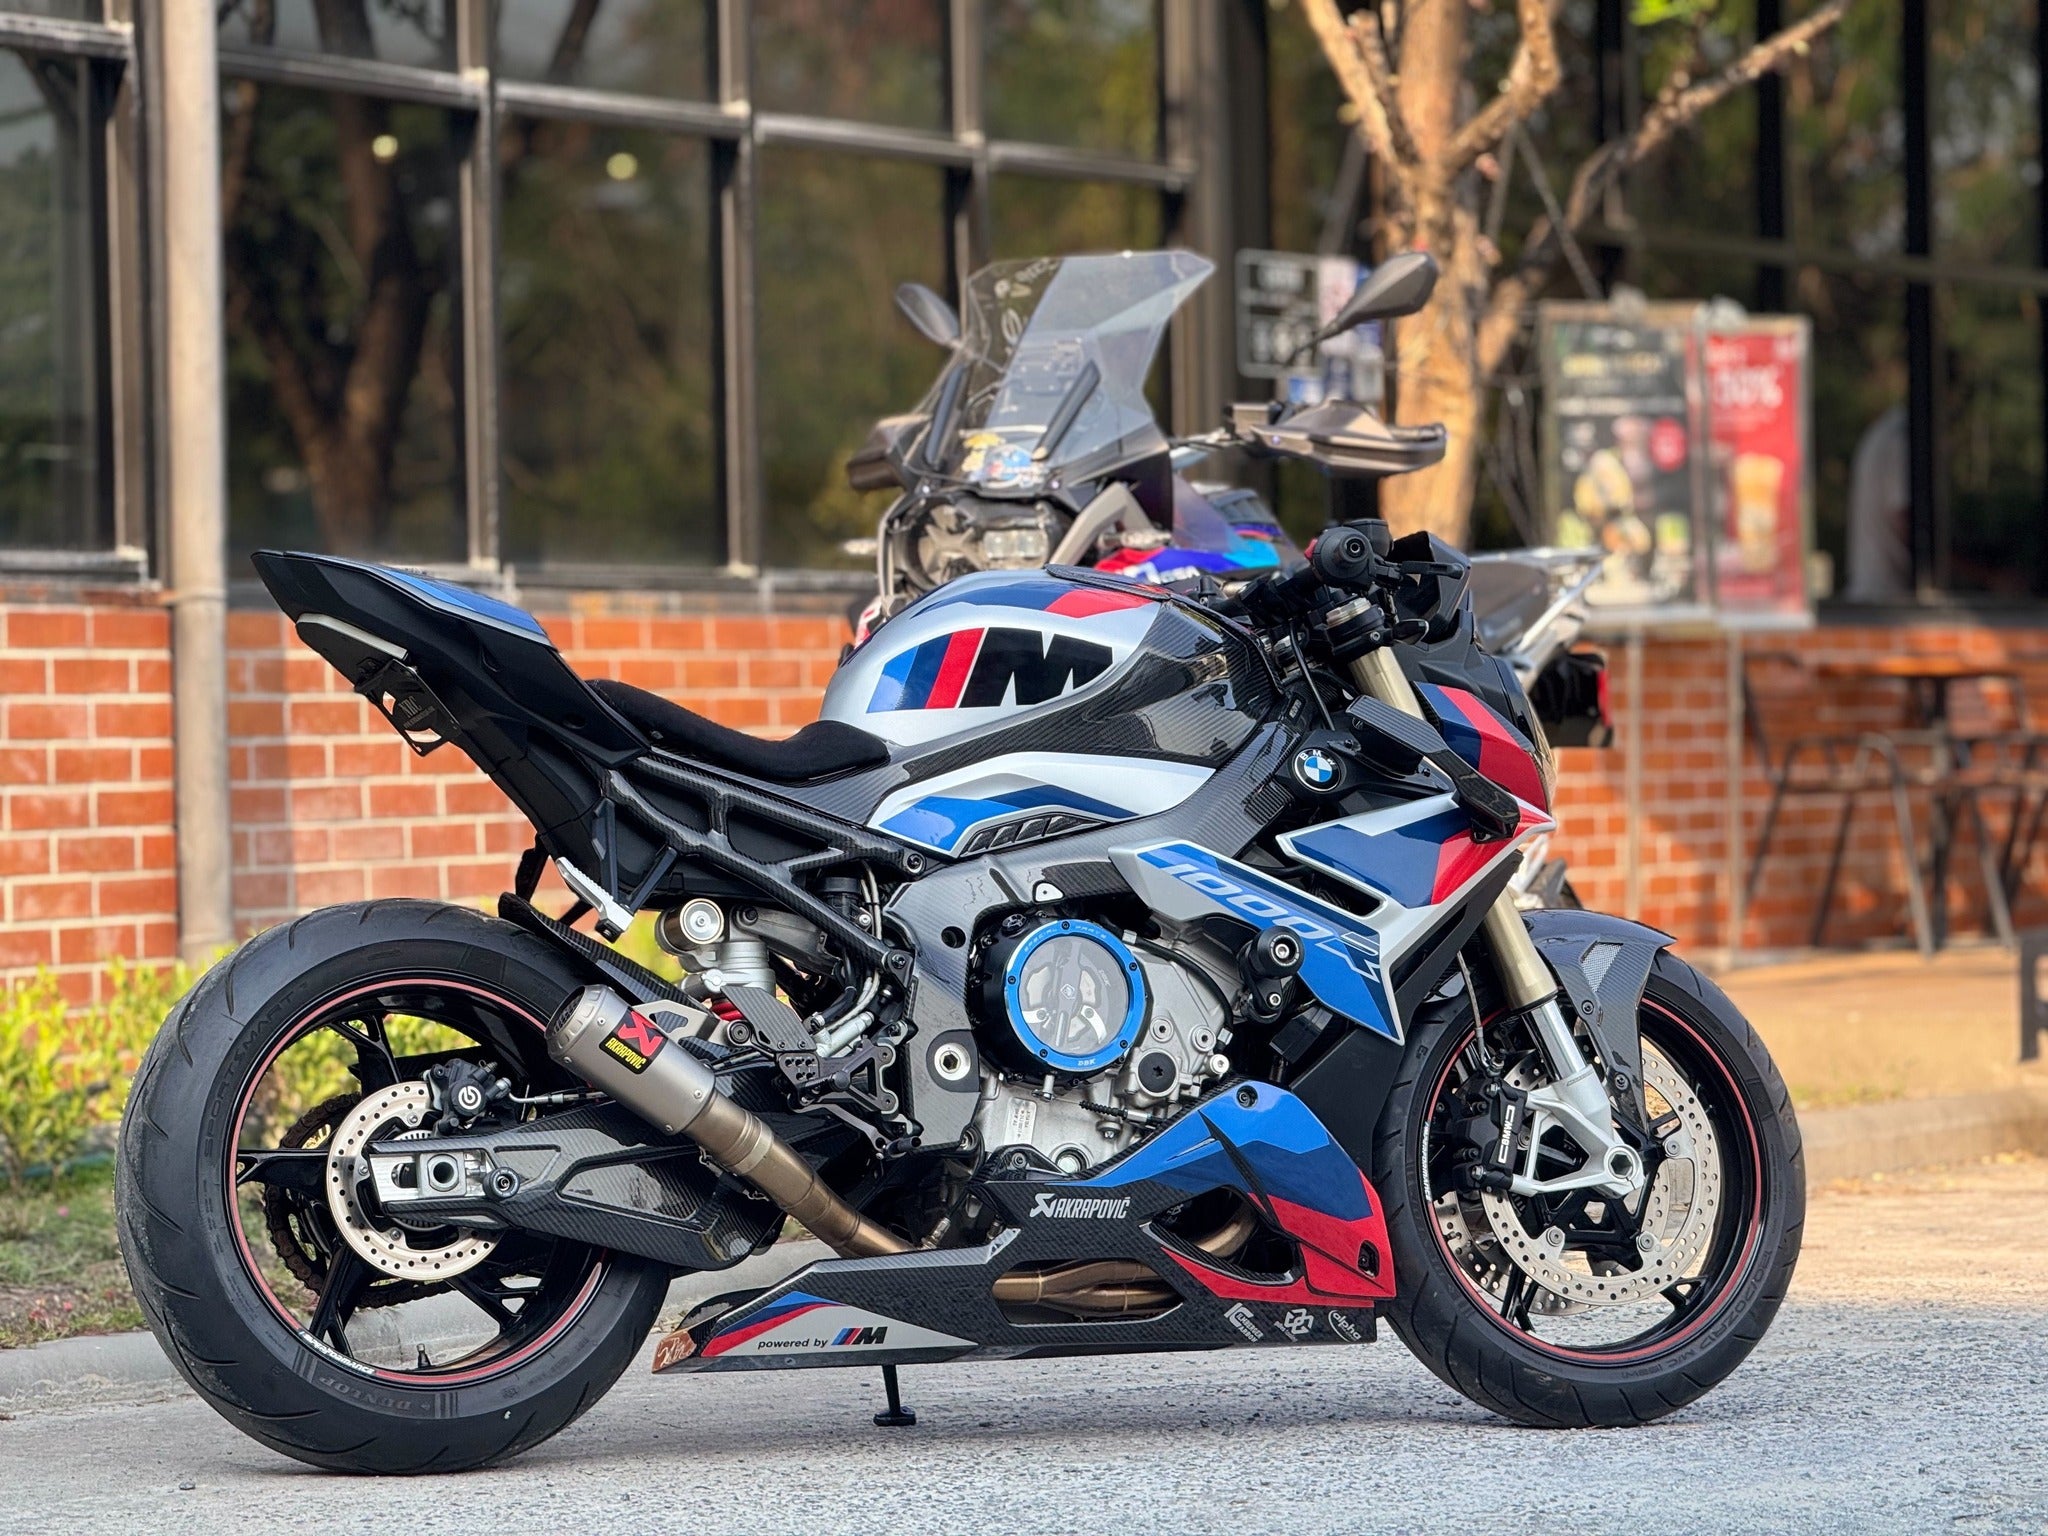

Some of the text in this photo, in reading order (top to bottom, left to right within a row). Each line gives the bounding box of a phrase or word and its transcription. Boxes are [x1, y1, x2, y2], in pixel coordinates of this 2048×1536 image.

[958, 626, 1114, 709] M
[1502, 1120, 1513, 1146] BMW
[1333, 1312, 1362, 1340] alpha
[757, 1338, 809, 1350] powered
[814, 1338, 828, 1349] by
[318, 1376, 413, 1411] DUNLOP
